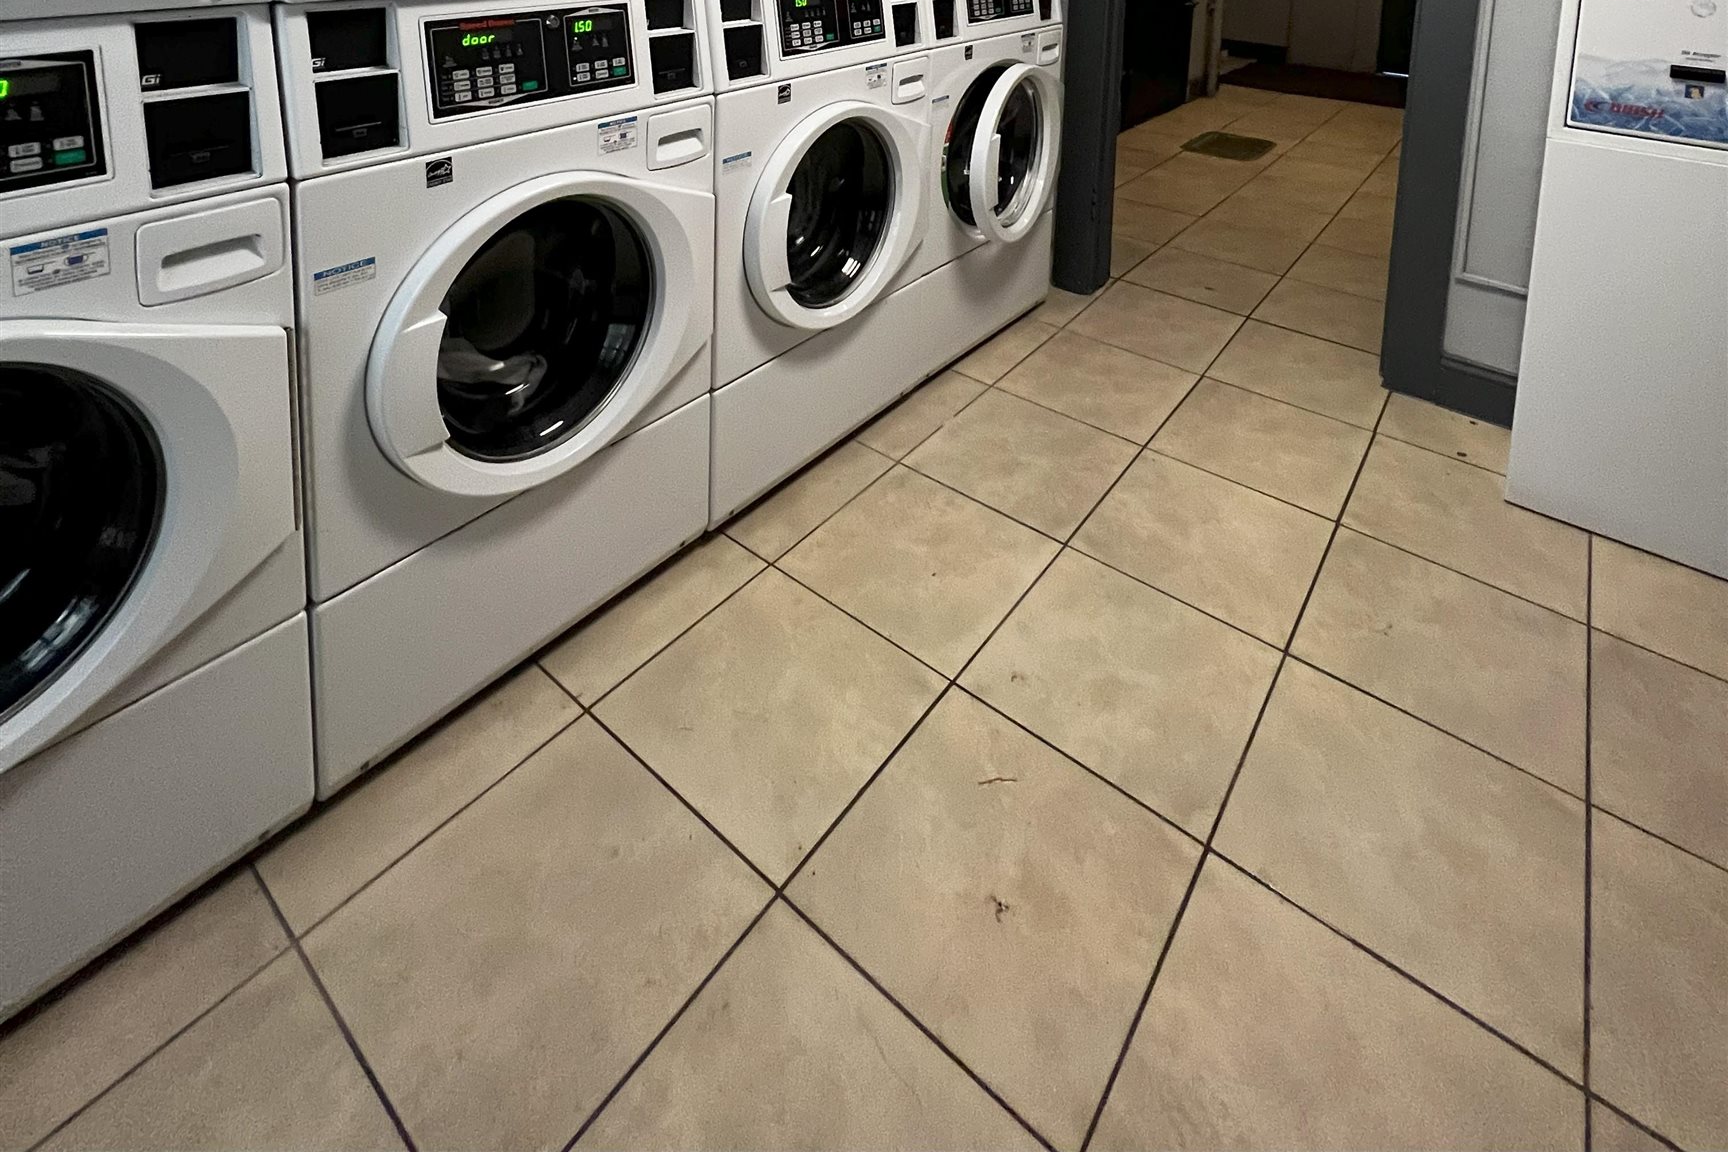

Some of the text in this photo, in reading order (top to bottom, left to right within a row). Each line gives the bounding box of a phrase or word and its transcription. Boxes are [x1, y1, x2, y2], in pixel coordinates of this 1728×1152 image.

[461, 33, 495, 47] door
[141, 73, 161, 86] Gi
[40, 234, 80, 248] NOTICE
[323, 260, 366, 277] NOTICE
